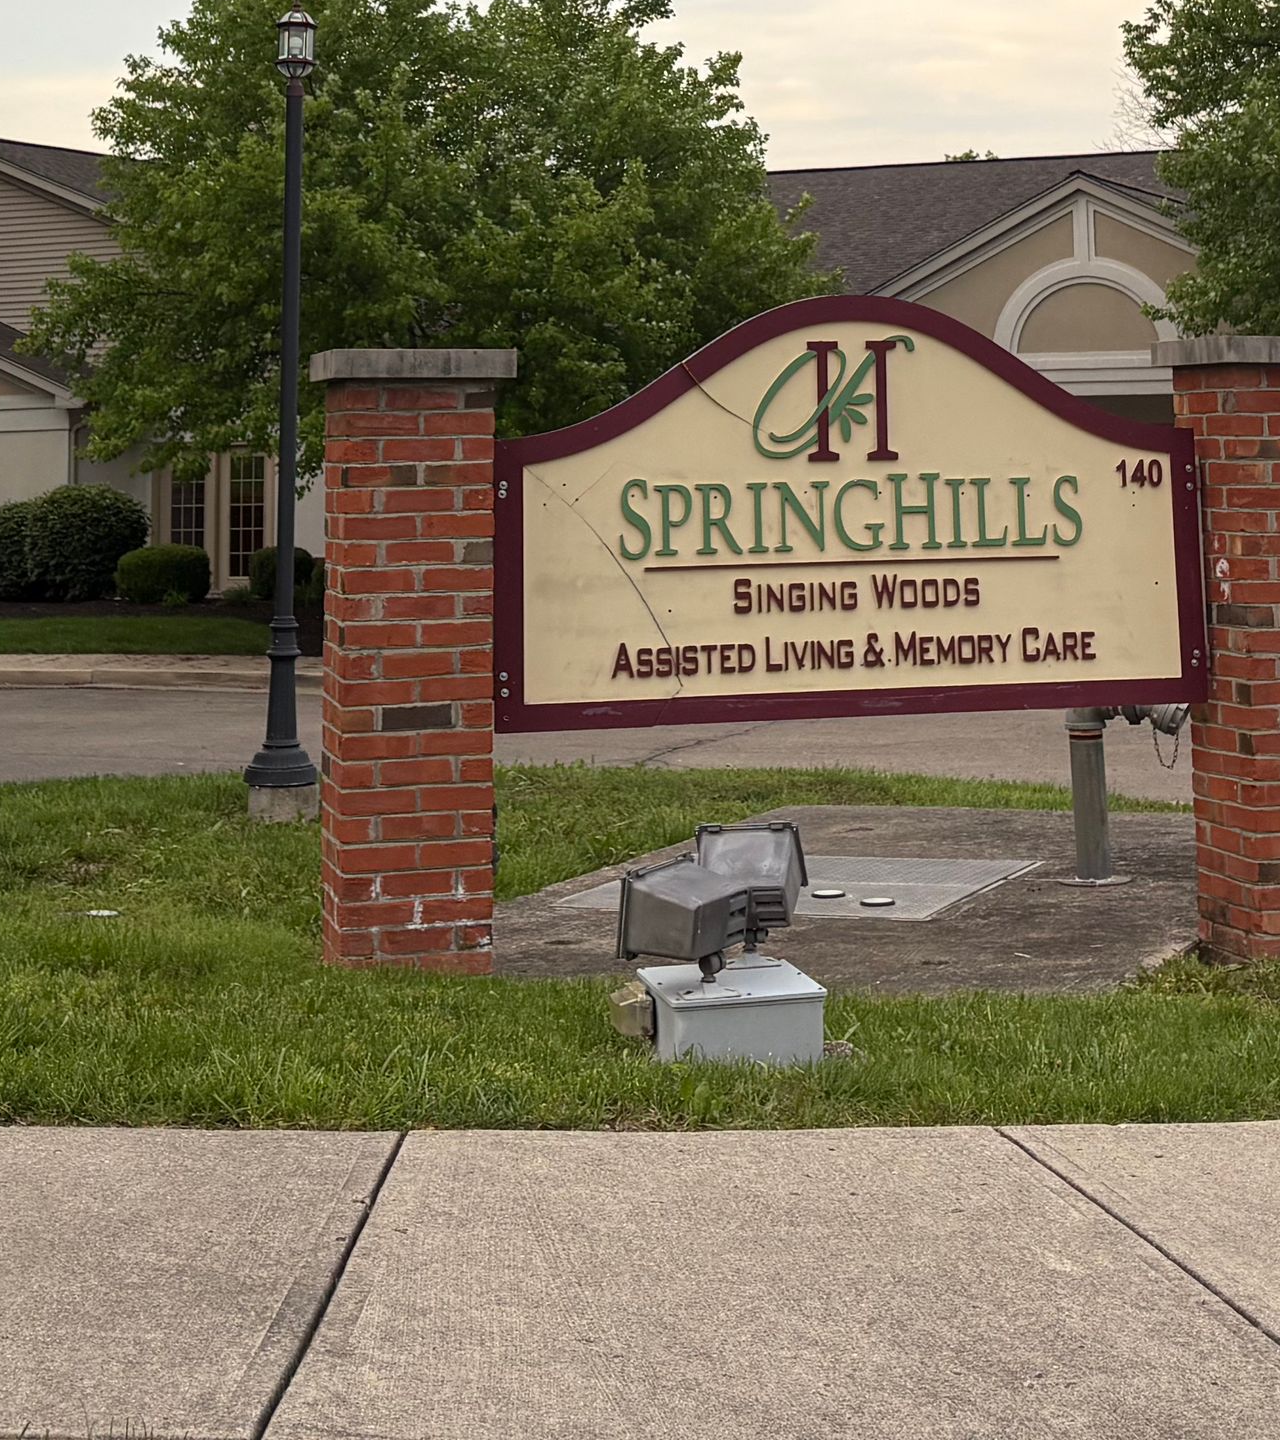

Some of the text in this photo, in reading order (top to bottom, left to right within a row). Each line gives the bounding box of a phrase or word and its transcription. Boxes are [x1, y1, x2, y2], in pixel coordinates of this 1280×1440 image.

[1115, 458, 1163, 488] 140
[619, 472, 1083, 561] SPRINGHILLS
[733, 573, 980, 615] SINGING WOODS
[611, 626, 1097, 679] ASSISTED LIVING & MEMORY CARE
